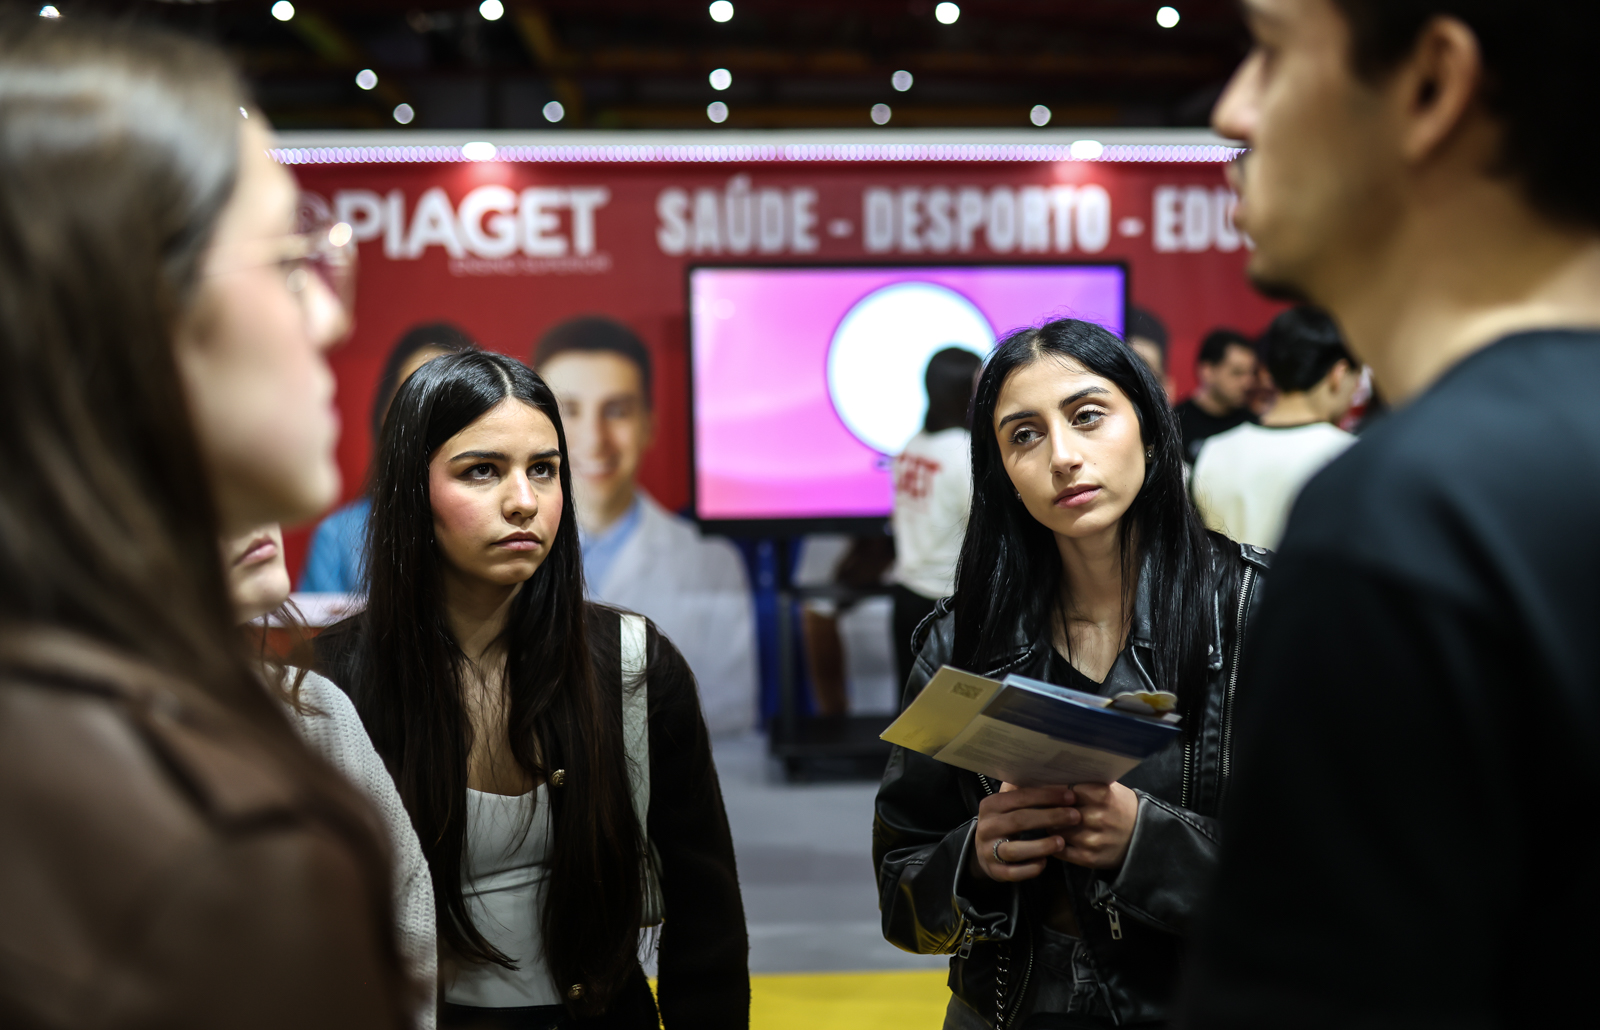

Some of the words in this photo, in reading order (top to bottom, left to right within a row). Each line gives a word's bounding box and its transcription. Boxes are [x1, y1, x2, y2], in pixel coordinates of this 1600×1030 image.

[335, 186, 609, 259] PIAGET
[656, 174, 819, 255] SAÚDE
[864, 186, 1111, 253] DESPORTO
[1154, 186, 1255, 252] EDU
